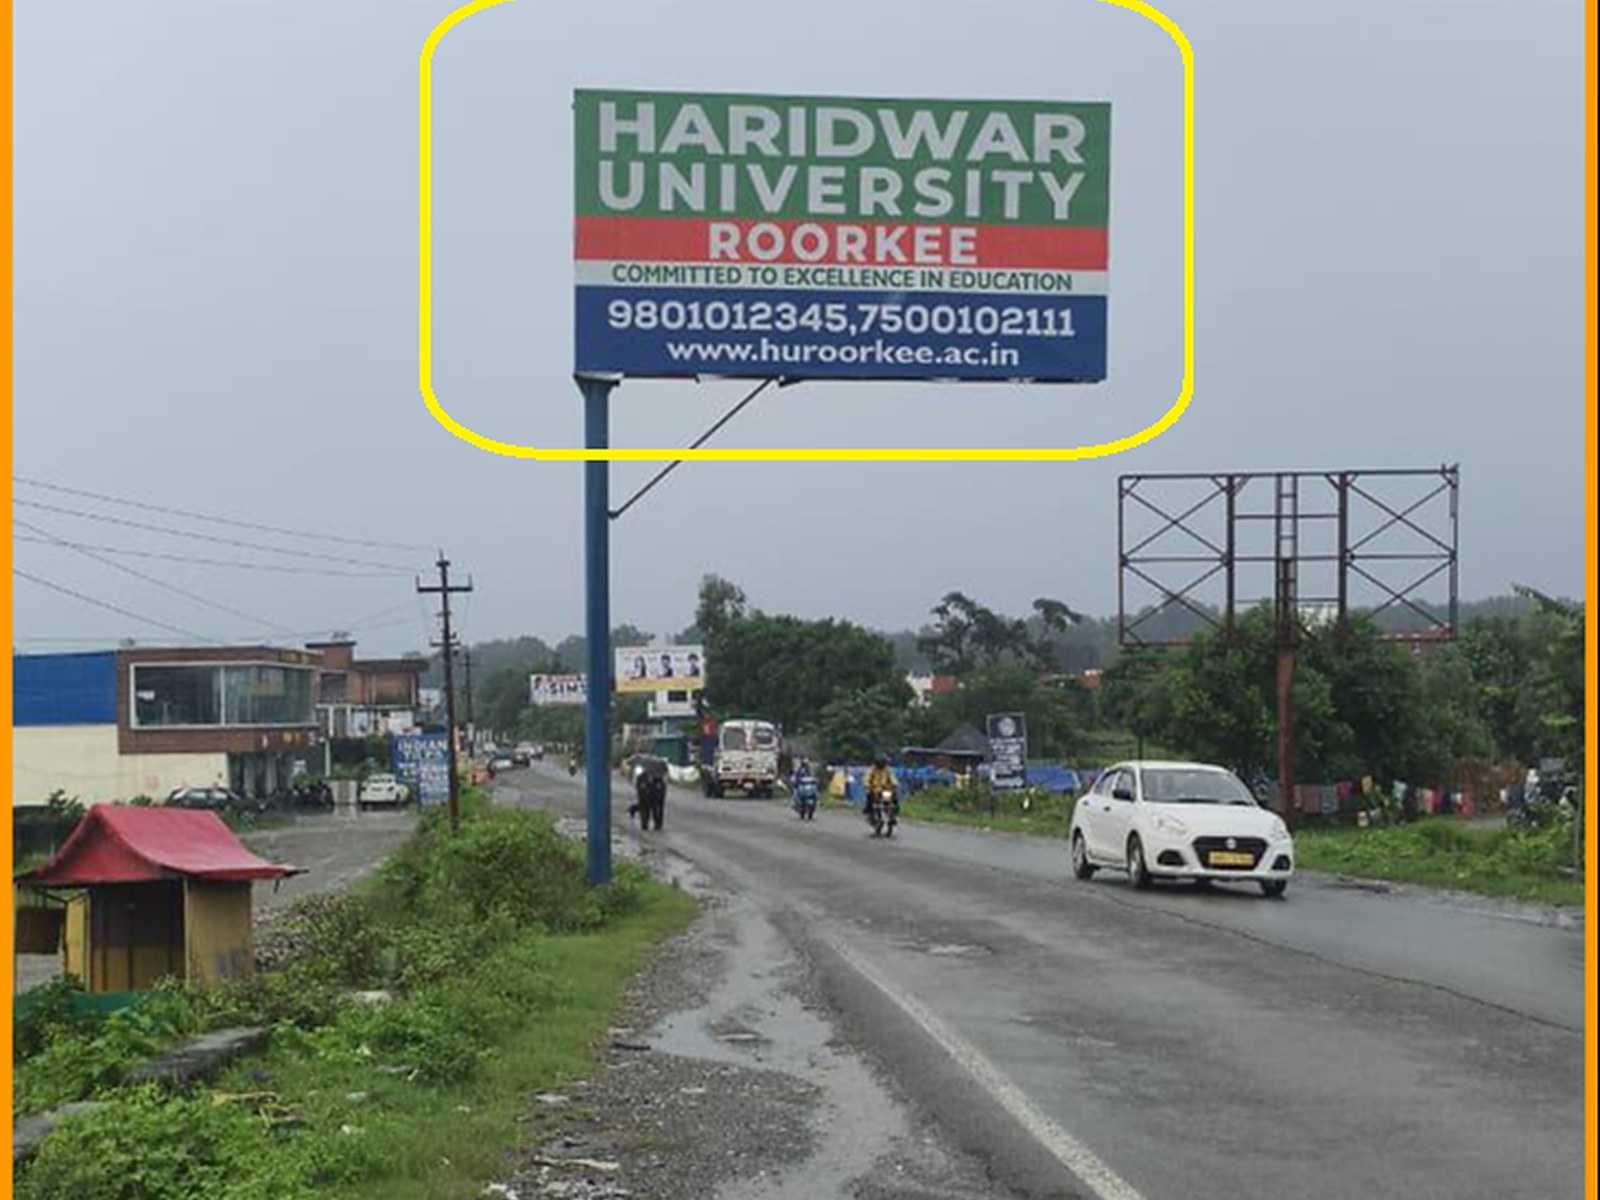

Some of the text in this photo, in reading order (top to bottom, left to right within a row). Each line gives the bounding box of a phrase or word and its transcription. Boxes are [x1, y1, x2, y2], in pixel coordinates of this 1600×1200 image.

[599, 101, 1086, 163] HARIDWAR
[599, 161, 1085, 220] UNIVERSITY
[709, 222, 978, 264] ROORKEE
[612, 265, 1073, 291] COMMITTED TO EXCELLENCE IN EDUCATION
[608, 301, 1075, 337] 9801012345,7500102111
[667, 339, 1020, 365] www.huroorkee.ac.in
